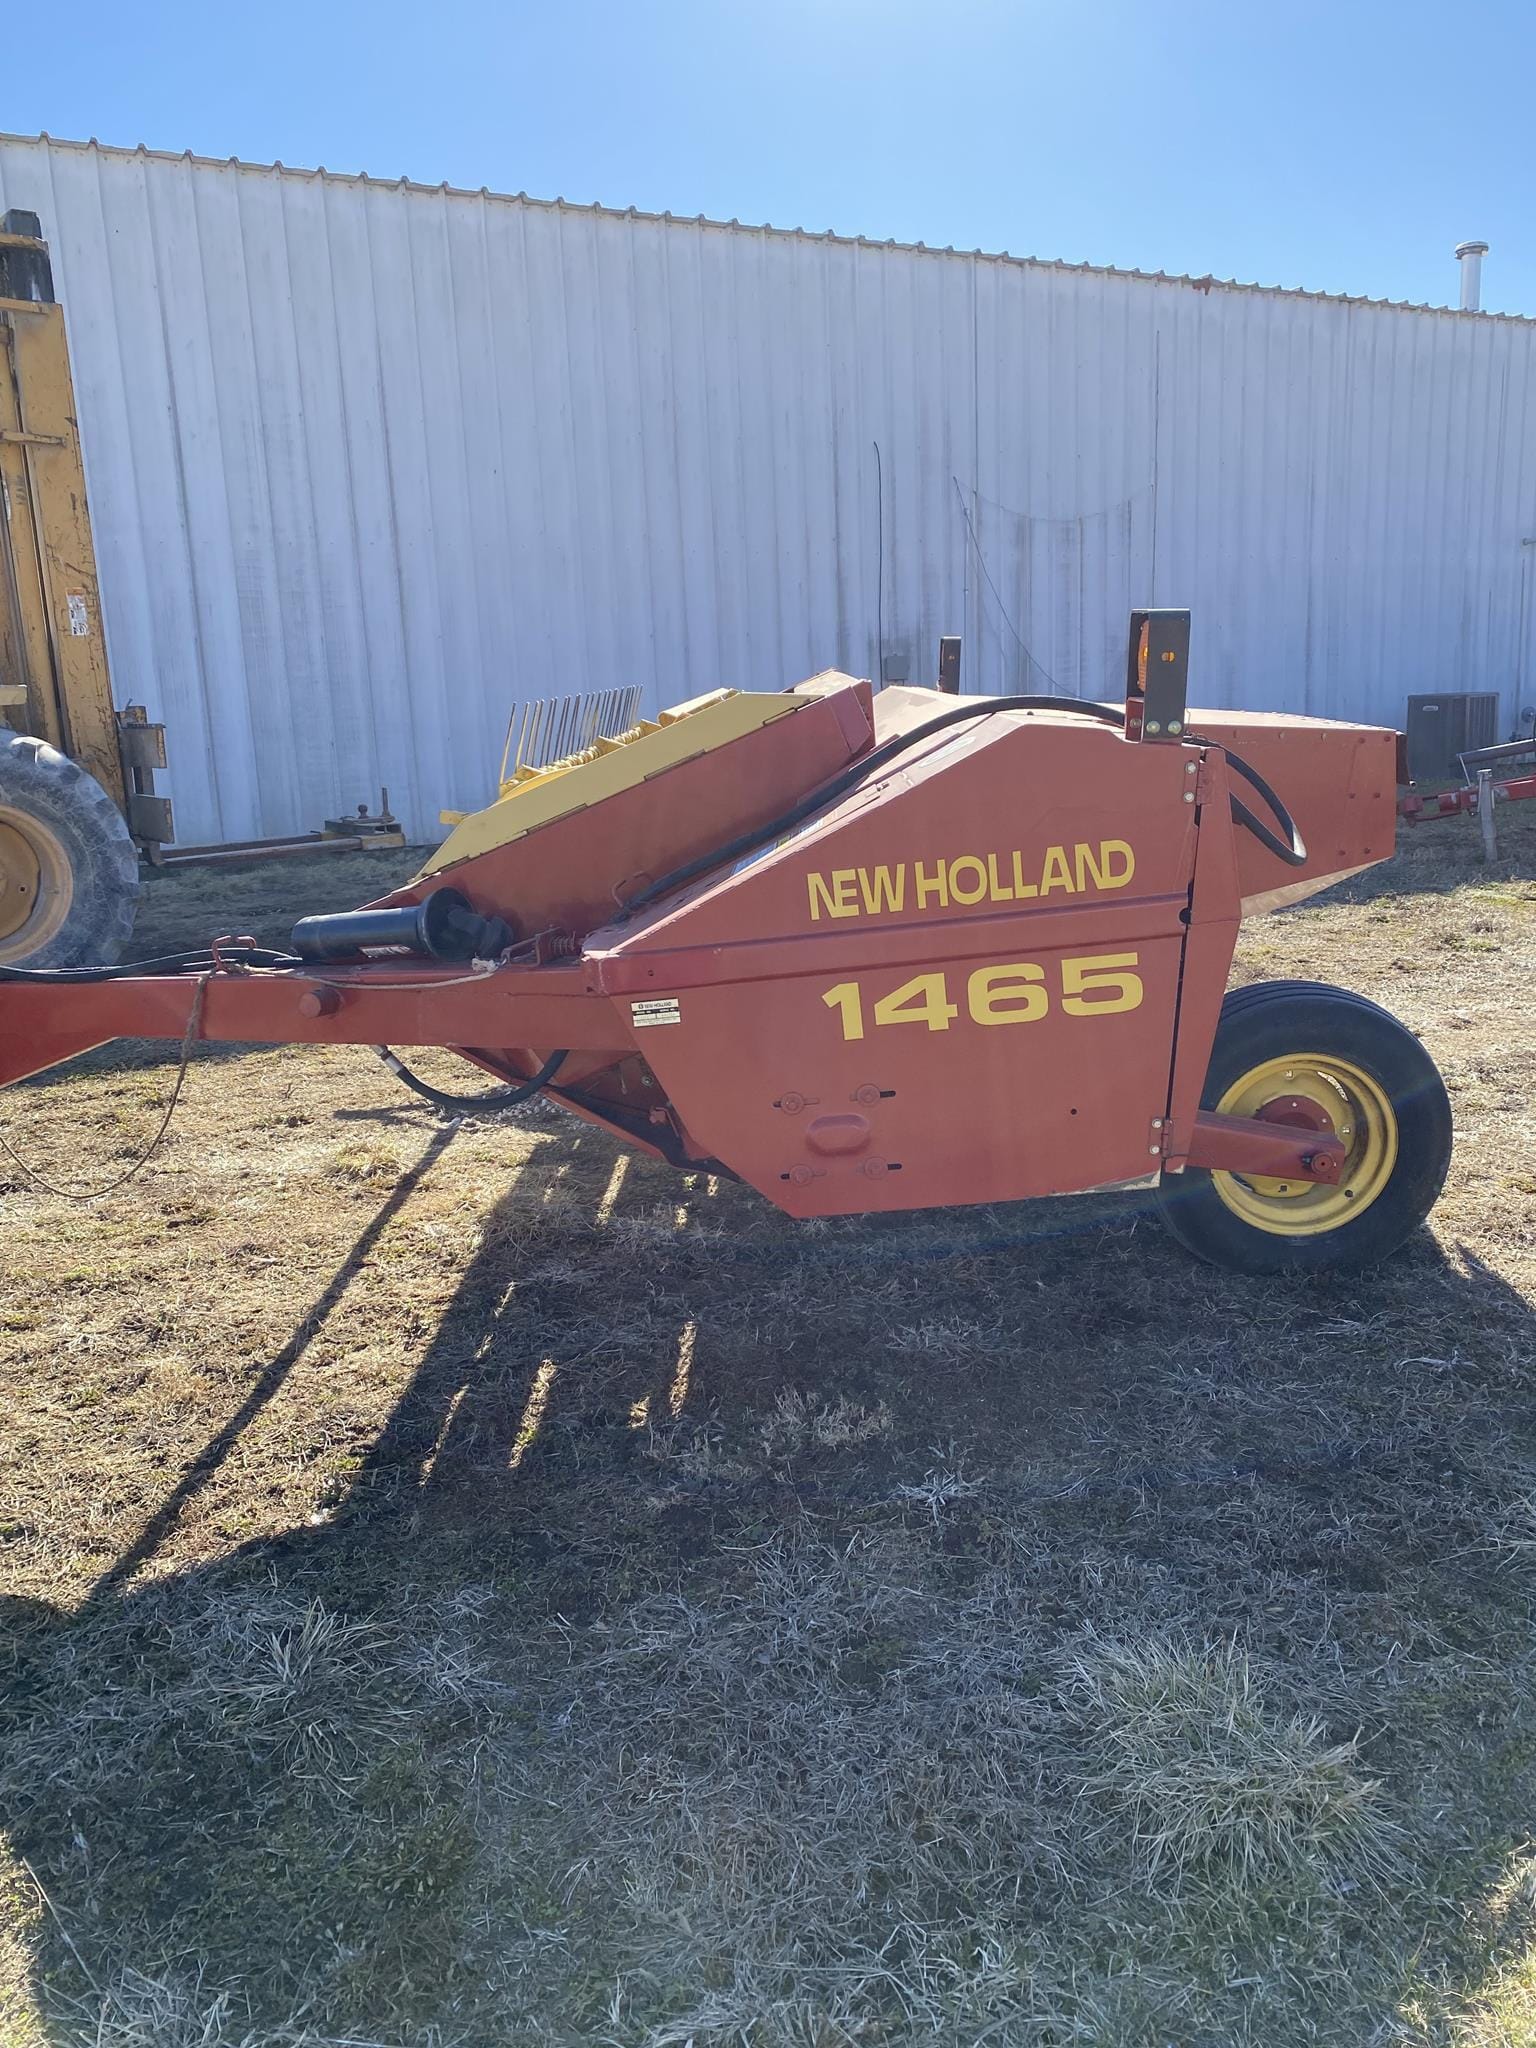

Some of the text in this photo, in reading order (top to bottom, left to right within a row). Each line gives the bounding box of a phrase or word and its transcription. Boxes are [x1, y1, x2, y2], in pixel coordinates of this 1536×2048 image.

[807, 839, 1136, 920] NEW HOLLAND
[821, 952, 1143, 1041] 1465
